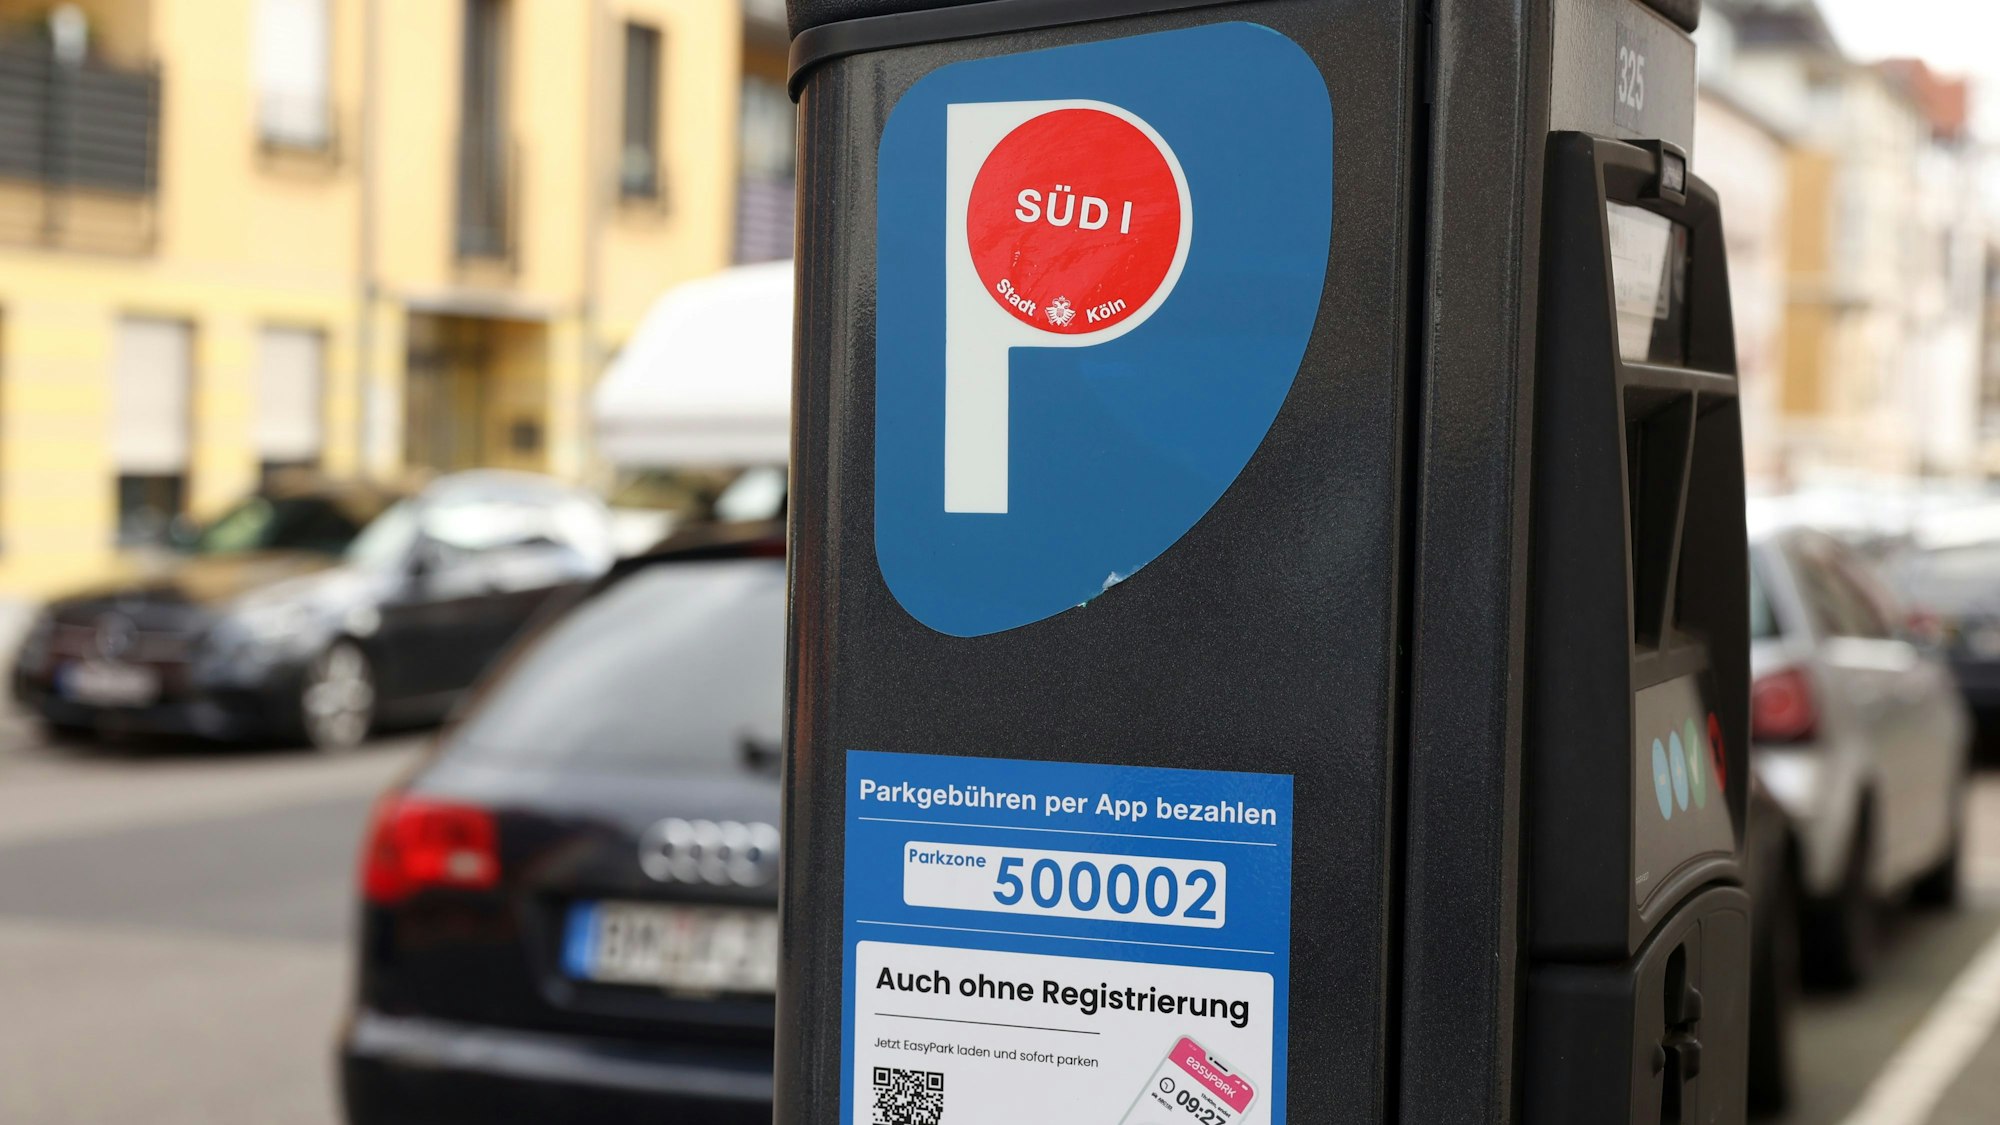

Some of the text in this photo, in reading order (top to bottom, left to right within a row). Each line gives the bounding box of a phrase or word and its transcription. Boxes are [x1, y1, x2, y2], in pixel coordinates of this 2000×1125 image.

[1618, 46, 1645, 111] 325
[1014, 184, 1133, 234] SÜD I
[944, 99, 1194, 514] P
[996, 278, 1127, 324] Stadt Köln
[859, 779, 1277, 826] Parkgebühren per App bezahlen
[909, 848, 987, 868] Parkzone
[993, 856, 1217, 920] 500002
[876, 967, 1249, 1028] Auch ohne Registrierung
[874, 1037, 1099, 1068] Jetzt EasyPark laden und sofort parken
[1176, 1090, 1226, 1125] 09:27
